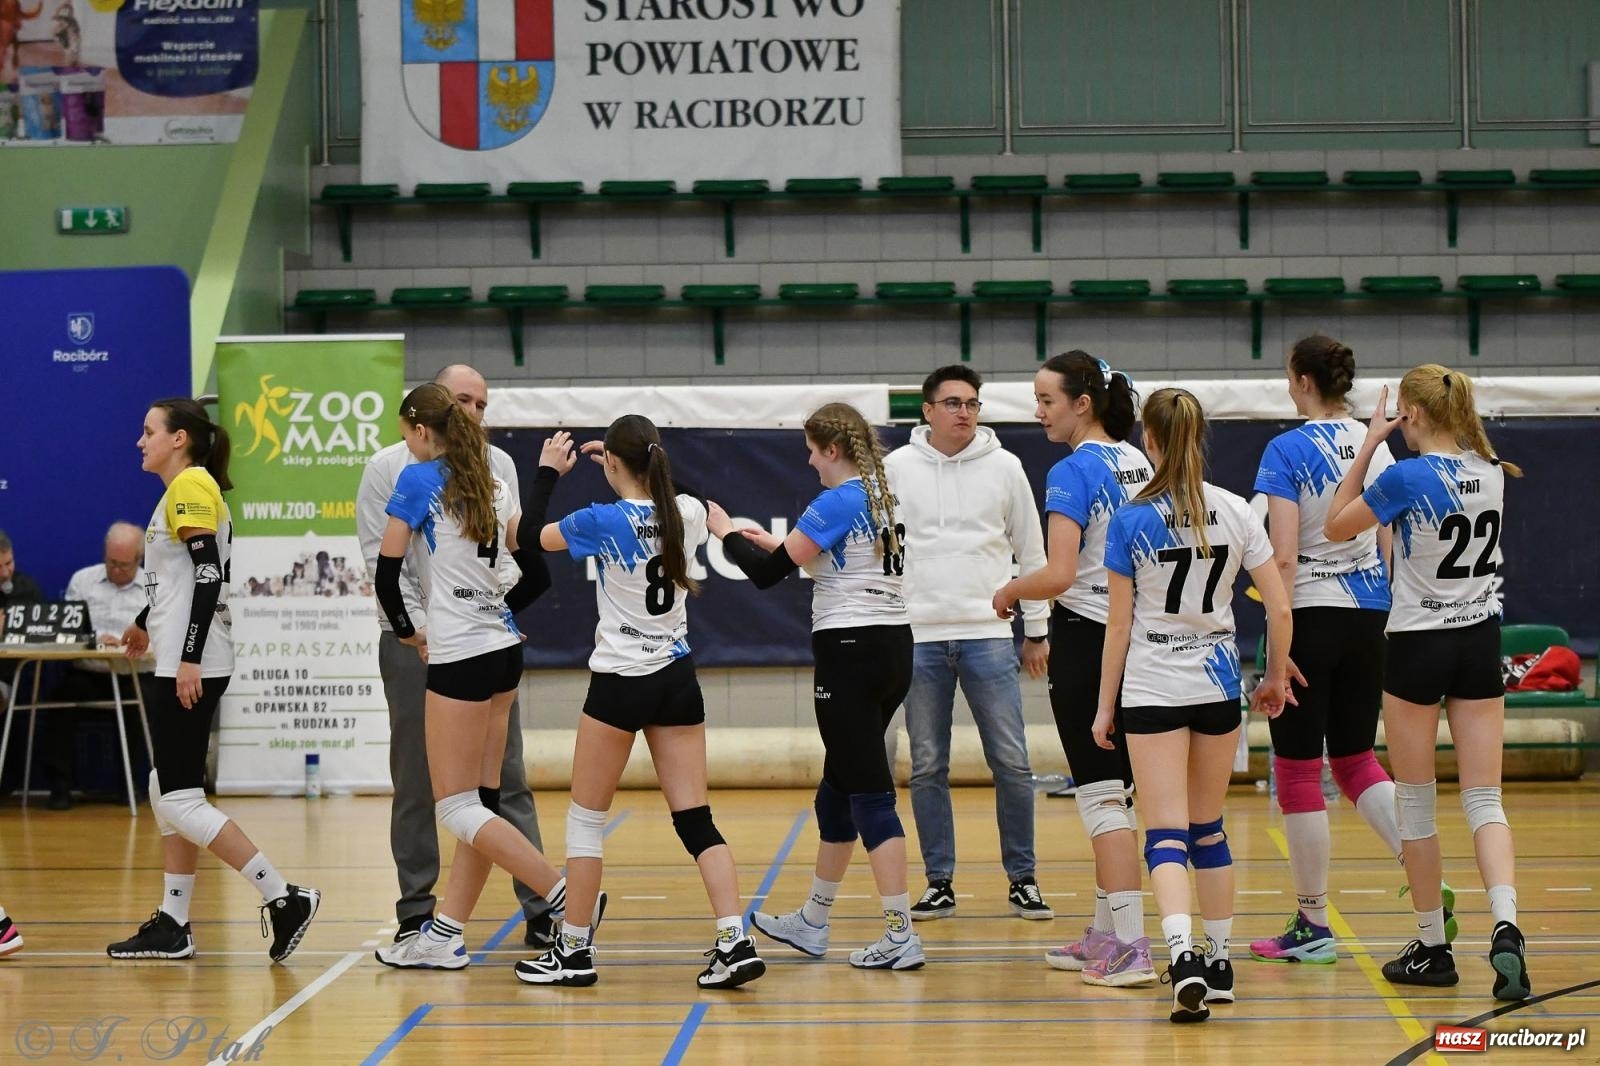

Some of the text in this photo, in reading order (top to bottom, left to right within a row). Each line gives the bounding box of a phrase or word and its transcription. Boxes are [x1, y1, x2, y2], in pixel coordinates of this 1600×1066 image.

[584, 0, 864, 22] STAROSTWO
[585, 38, 861, 76] POWIATOWE
[583, 97, 865, 130] W RACIBORZU
[53, 349, 109, 362] Racibórz
[288, 390, 385, 423] ZOO
[282, 422, 384, 453] MAR
[282, 454, 313, 467] sklep
[1338, 446, 1356, 460] LIS
[1459, 479, 1481, 495] FAIT
[1436, 509, 1501, 580] 22
[645, 555, 675, 616] 8
[1157, 544, 1230, 615] 77
[6, 604, 84, 629] 15 0 2 25
[185, 622, 199, 653] ORACZ
[235, 642, 379, 657] ZAPRASZAM
[252, 669, 290, 680] DŁUGA
[295, 669, 309, 680] 10
[274, 684, 354, 697] SŁOWACKIEGO
[358, 685, 372, 696] 59
[255, 702, 309, 714] OPAWSKA
[313, 702, 327, 713] 82
[294, 718, 339, 730] RUDZKA
[343, 718, 357, 729] 37
